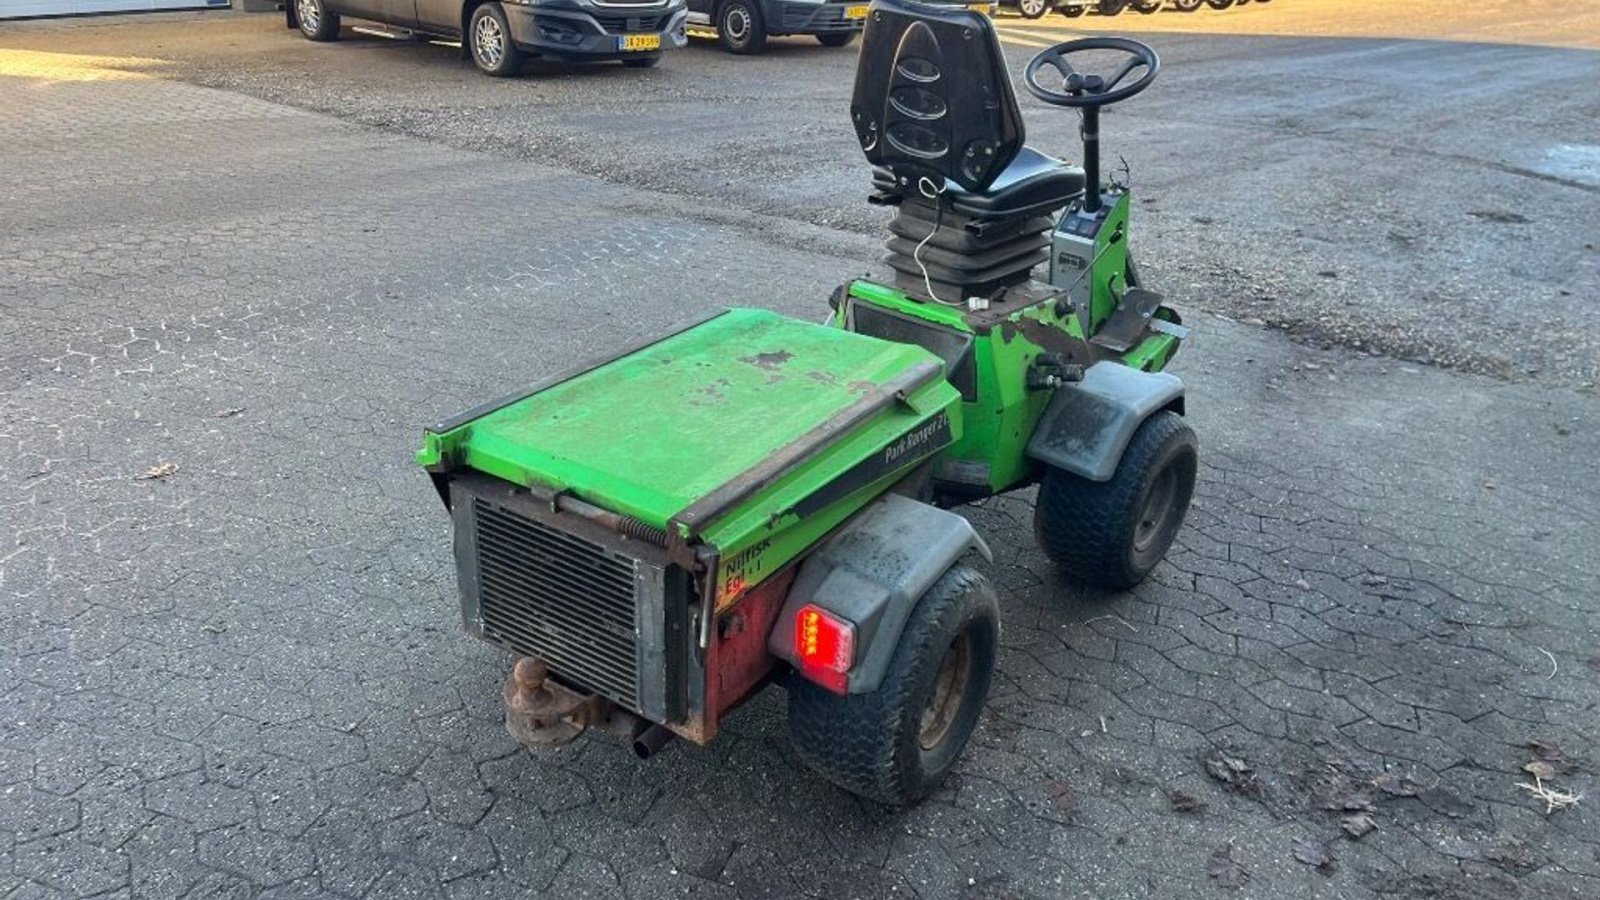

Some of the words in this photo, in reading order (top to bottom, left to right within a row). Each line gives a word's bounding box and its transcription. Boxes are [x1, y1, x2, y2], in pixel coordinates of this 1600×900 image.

[885, 437, 905, 464] Park
[907, 420, 937, 450] Ranger
[727, 537, 770, 577] Nilfisk
